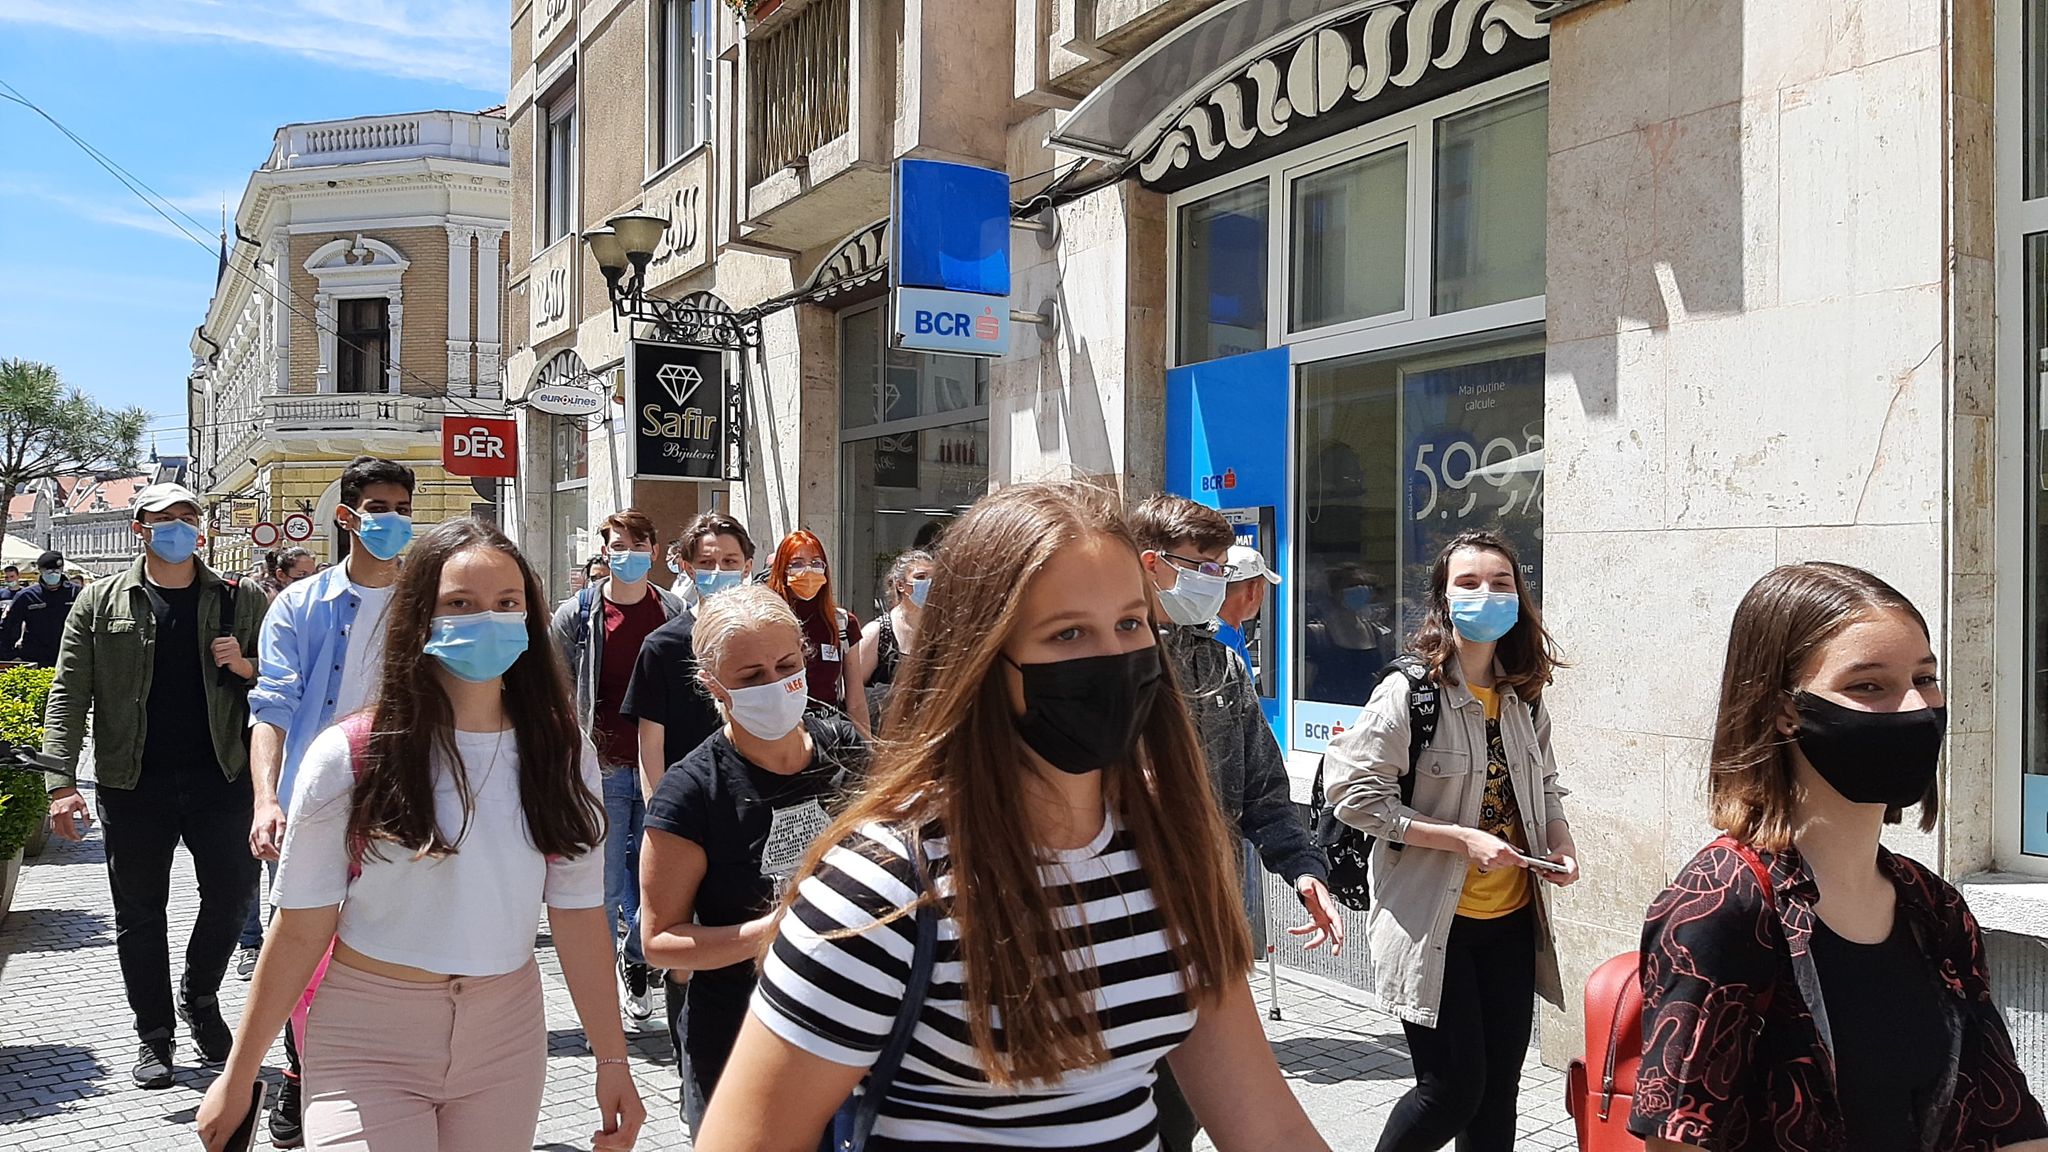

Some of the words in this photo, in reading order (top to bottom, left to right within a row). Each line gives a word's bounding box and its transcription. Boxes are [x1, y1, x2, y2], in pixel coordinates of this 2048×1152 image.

[915, 310, 970, 337] BCR
[1458, 384, 1475, 396] Mai
[1465, 398, 1496, 411] calcule
[642, 404, 717, 439] Safir
[662, 441, 716, 463] Bijuterii
[1202, 475, 1223, 491] BCR
[1305, 723, 1329, 740] BCR
